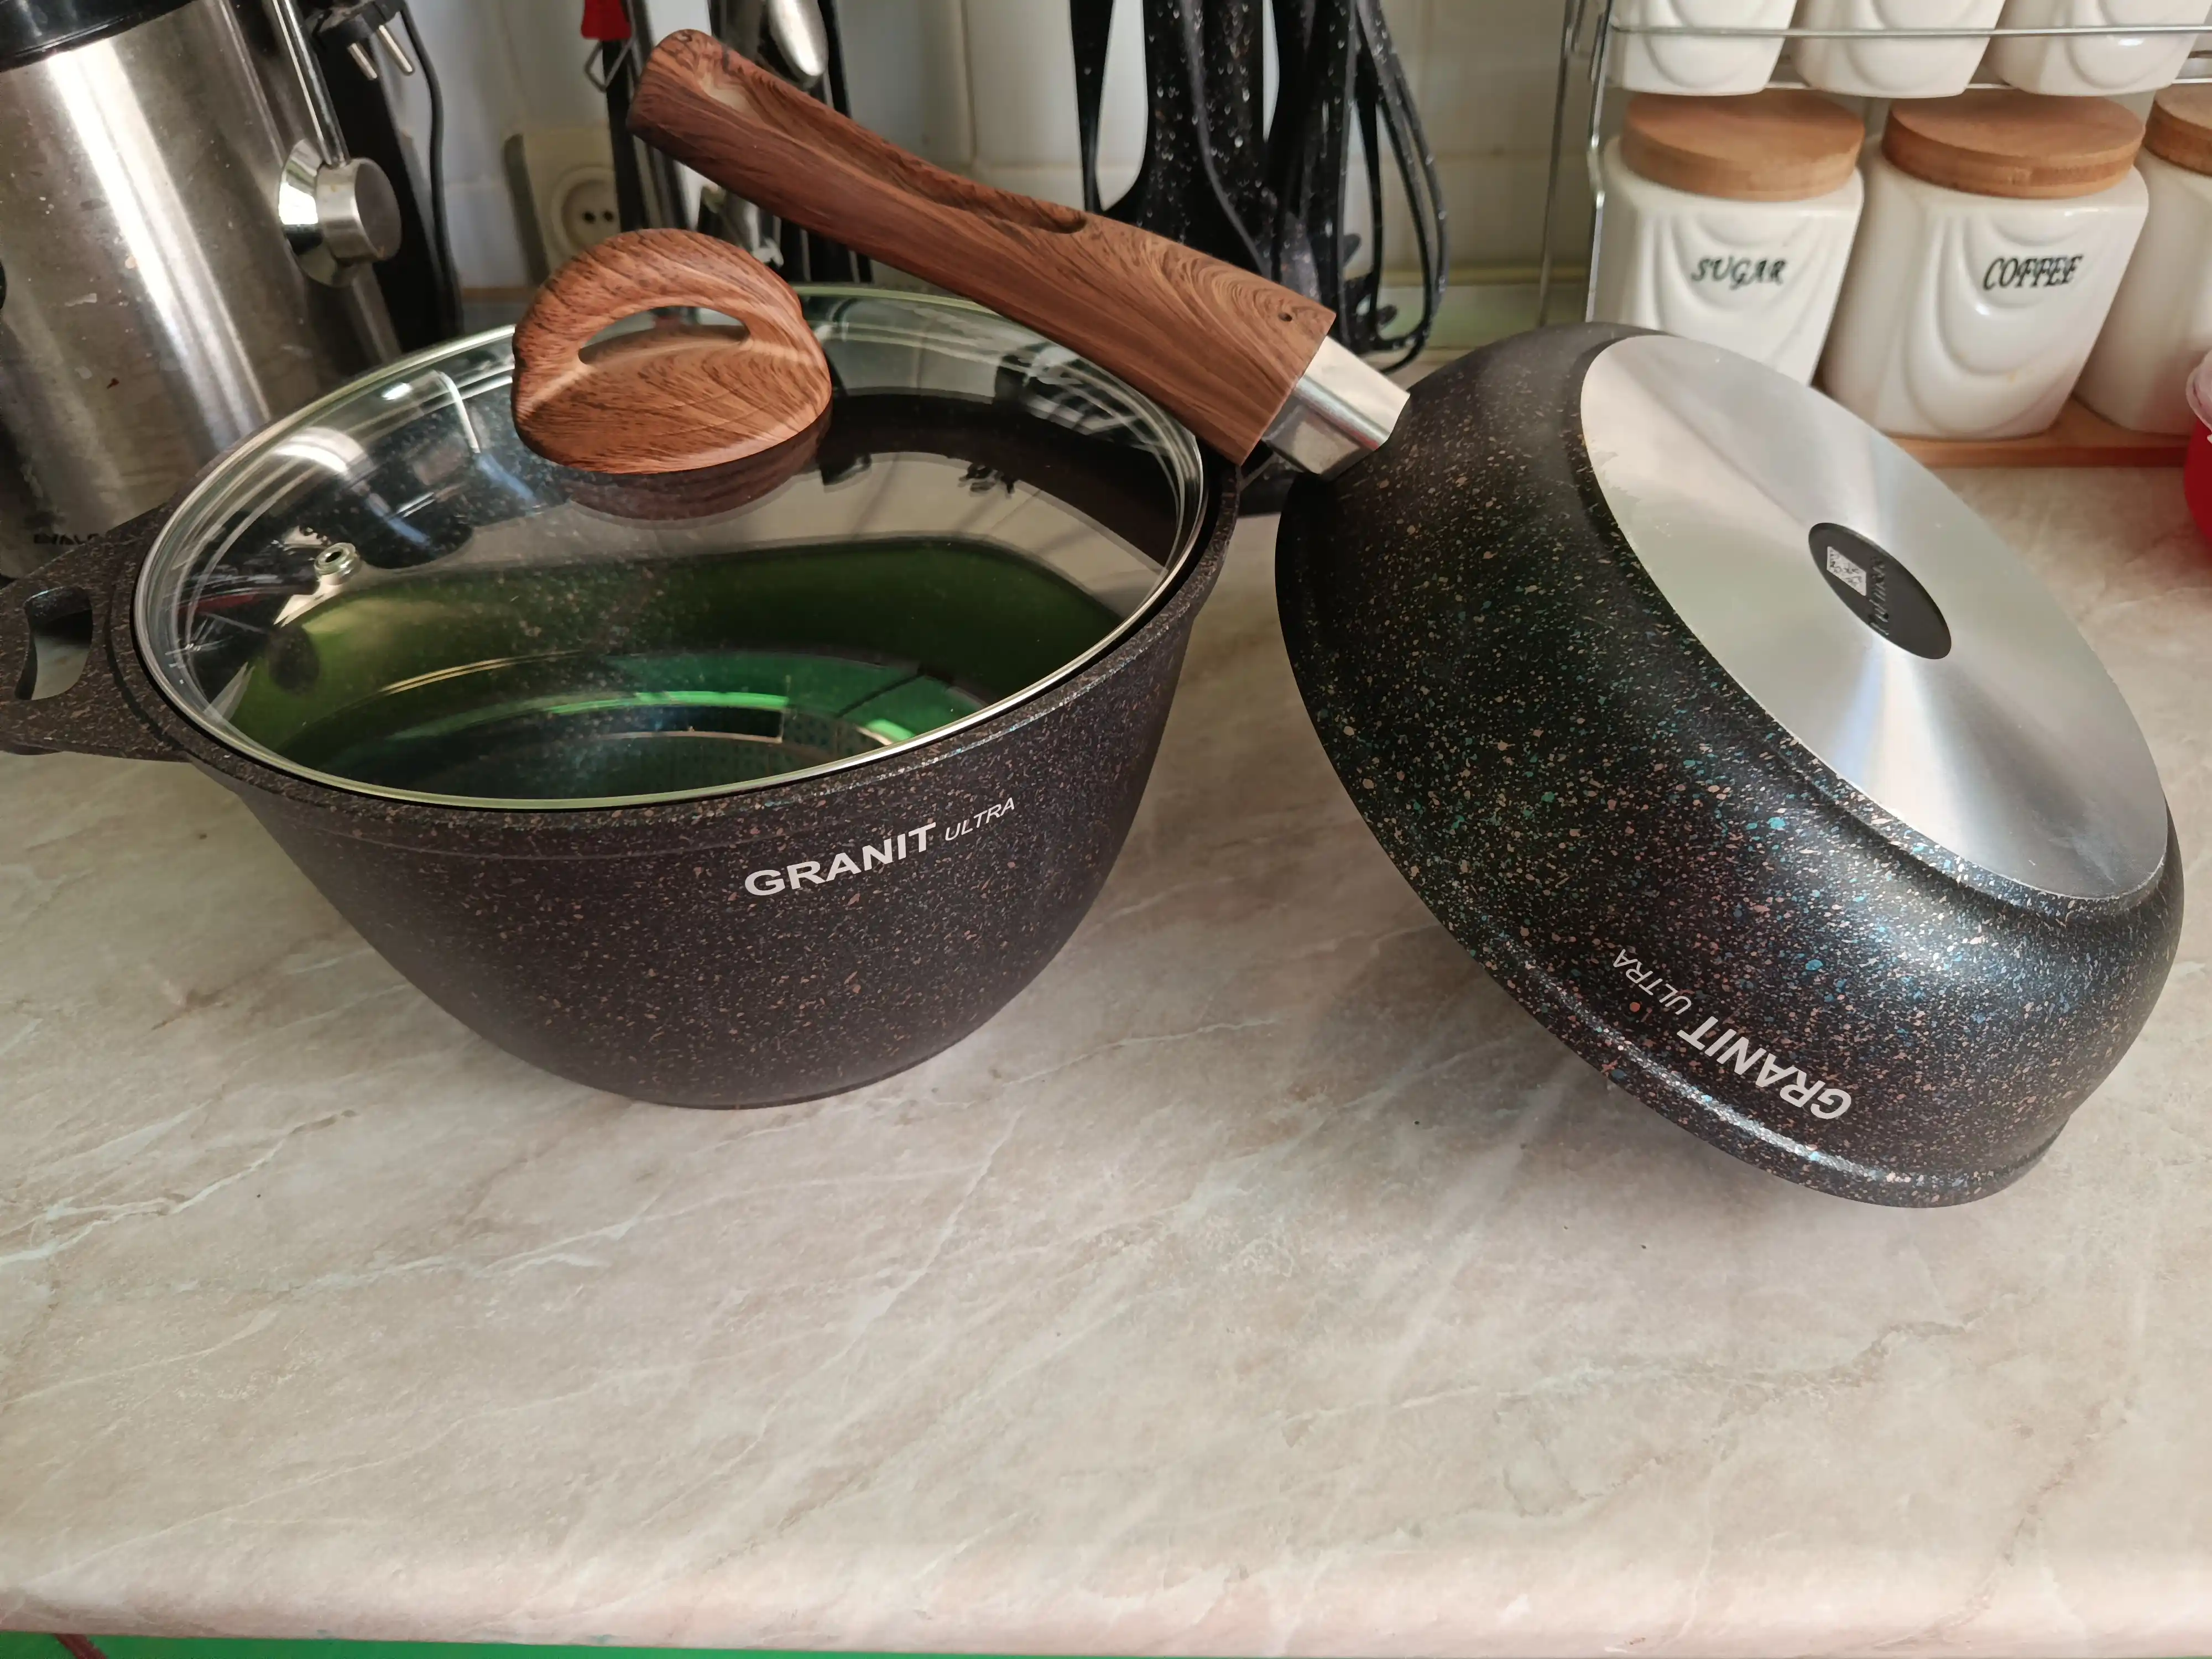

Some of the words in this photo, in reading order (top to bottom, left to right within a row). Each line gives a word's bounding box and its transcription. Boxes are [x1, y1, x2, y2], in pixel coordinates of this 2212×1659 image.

[1691, 256, 1786, 290] SUGAR
[1983, 253, 2083, 290] COFFEE
[744, 822, 936, 896] GRANIT
[945, 797, 1015, 841] ULTRA
[1613, 948, 1692, 1015] ULTRA
[1676, 1016, 1852, 1120] GRANIT
